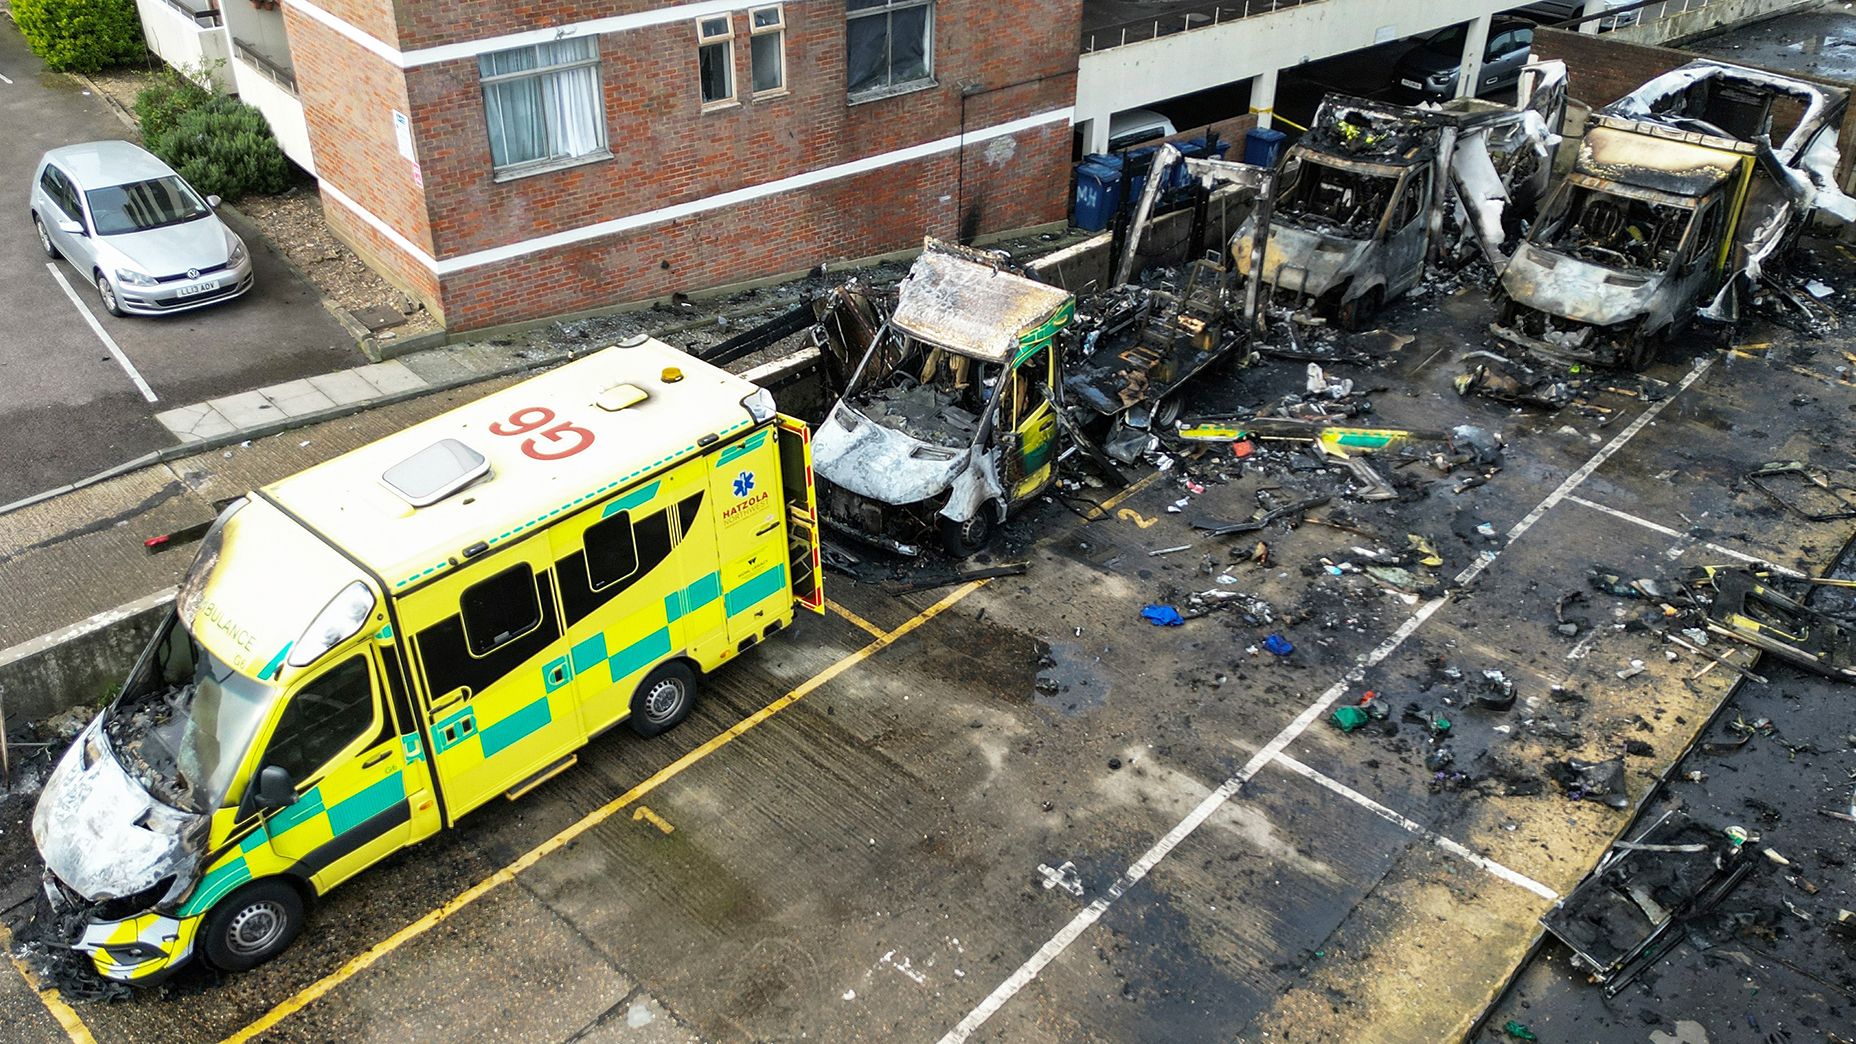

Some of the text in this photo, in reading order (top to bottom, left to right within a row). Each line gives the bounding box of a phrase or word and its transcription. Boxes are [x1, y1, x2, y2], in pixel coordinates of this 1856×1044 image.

[489, 407, 595, 461] G6
[723, 491, 769, 519] HATZOLA
[1117, 508, 1158, 528] 2
[632, 805, 675, 834] 1
